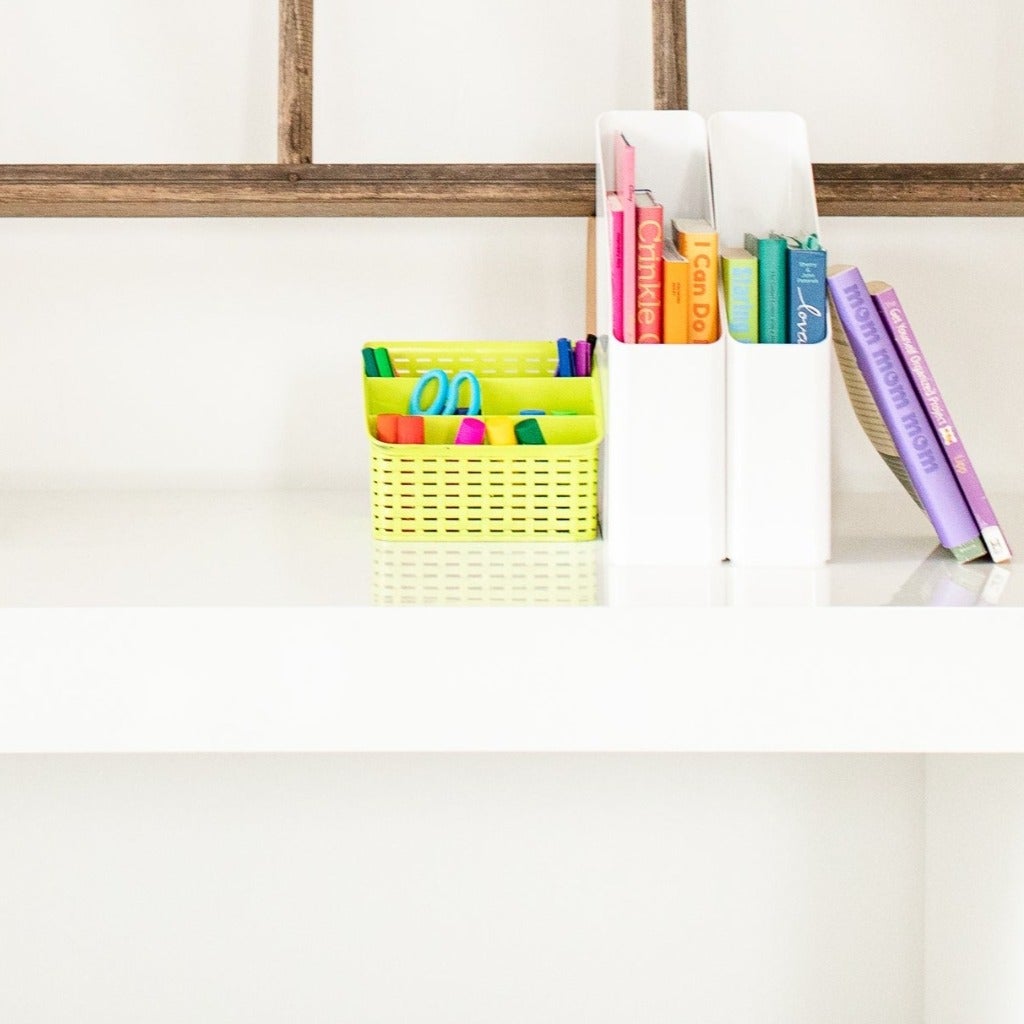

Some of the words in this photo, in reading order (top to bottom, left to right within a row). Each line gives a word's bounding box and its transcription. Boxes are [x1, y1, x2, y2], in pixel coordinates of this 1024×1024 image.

[637, 220, 660, 326] Crinkle
[693, 254, 711, 296] Can
[694, 239, 711, 247] I
[693, 303, 711, 332] Do
[845, 283, 880, 346] mom
[873, 349, 909, 409] mom
[902, 412, 938, 474] mom
[889, 308, 902, 324] Get
[896, 323, 916, 357] Yourself
[910, 356, 934, 397] Organized
[927, 397, 947, 427] Project
